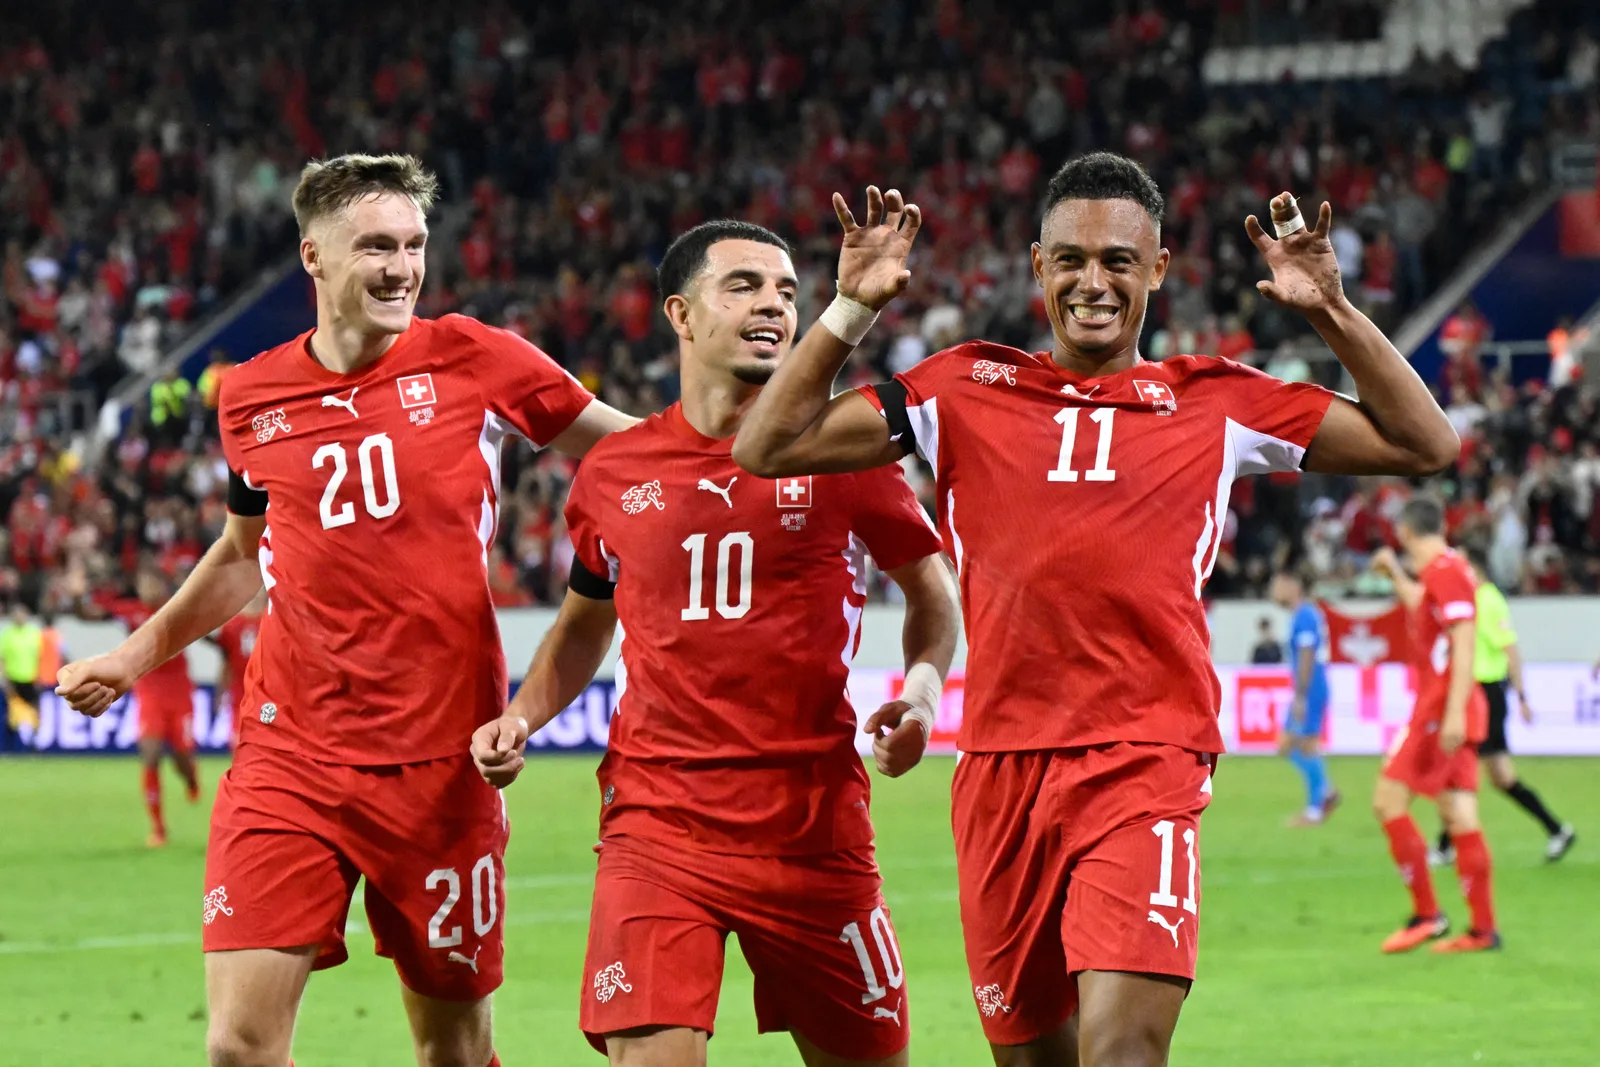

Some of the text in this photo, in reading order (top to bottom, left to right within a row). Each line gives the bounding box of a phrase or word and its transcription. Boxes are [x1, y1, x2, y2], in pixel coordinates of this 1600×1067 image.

[312, 432, 400, 530] 20
[1047, 407, 1117, 482] 11
[681, 531, 754, 621] 10
[425, 853, 497, 948] 20
[1150, 820, 1197, 915] 11
[839, 905, 903, 1005] 10
